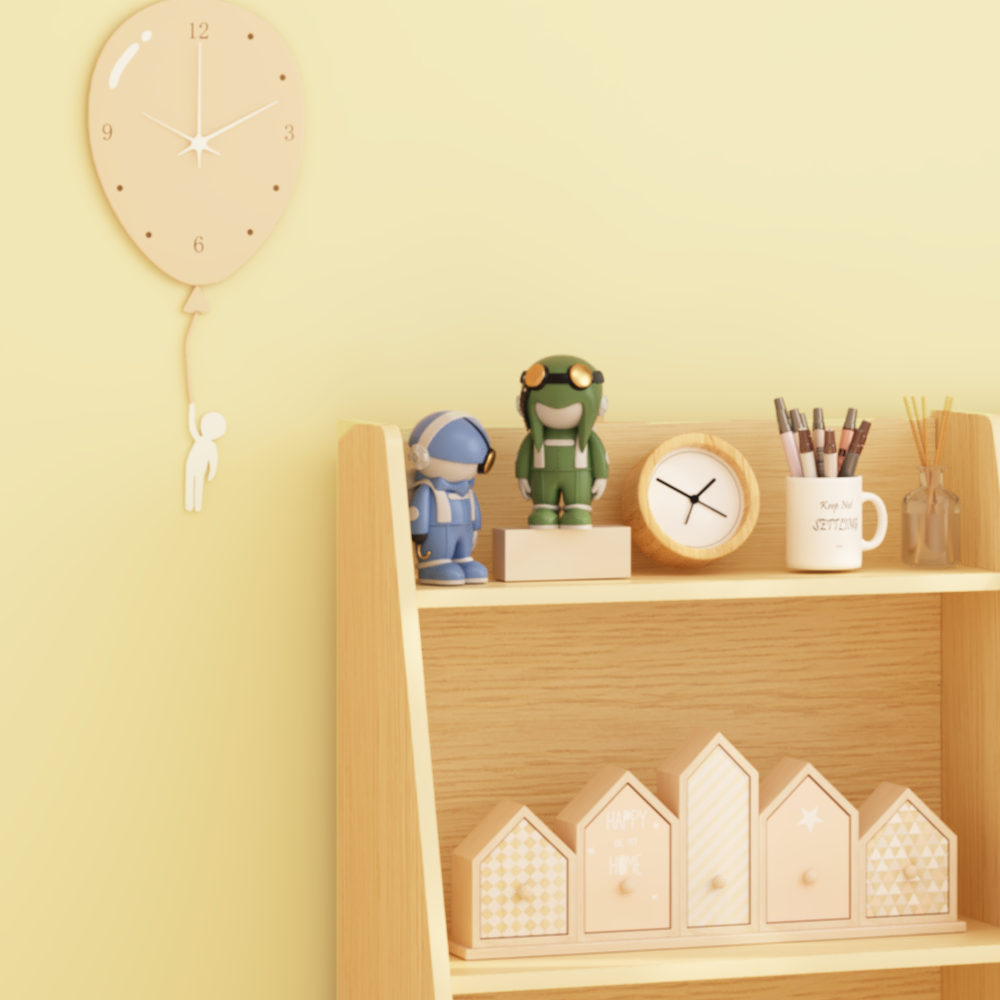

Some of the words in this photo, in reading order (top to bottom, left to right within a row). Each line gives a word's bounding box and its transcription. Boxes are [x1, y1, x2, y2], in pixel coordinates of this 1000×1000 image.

[189, 21, 210, 40] 12
[102, 123, 113, 141] 9
[284, 123, 295, 142] 3
[193, 235, 205, 254] 6
[605, 809, 648, 831] HAPPY
[608, 853, 643, 876] HOME
